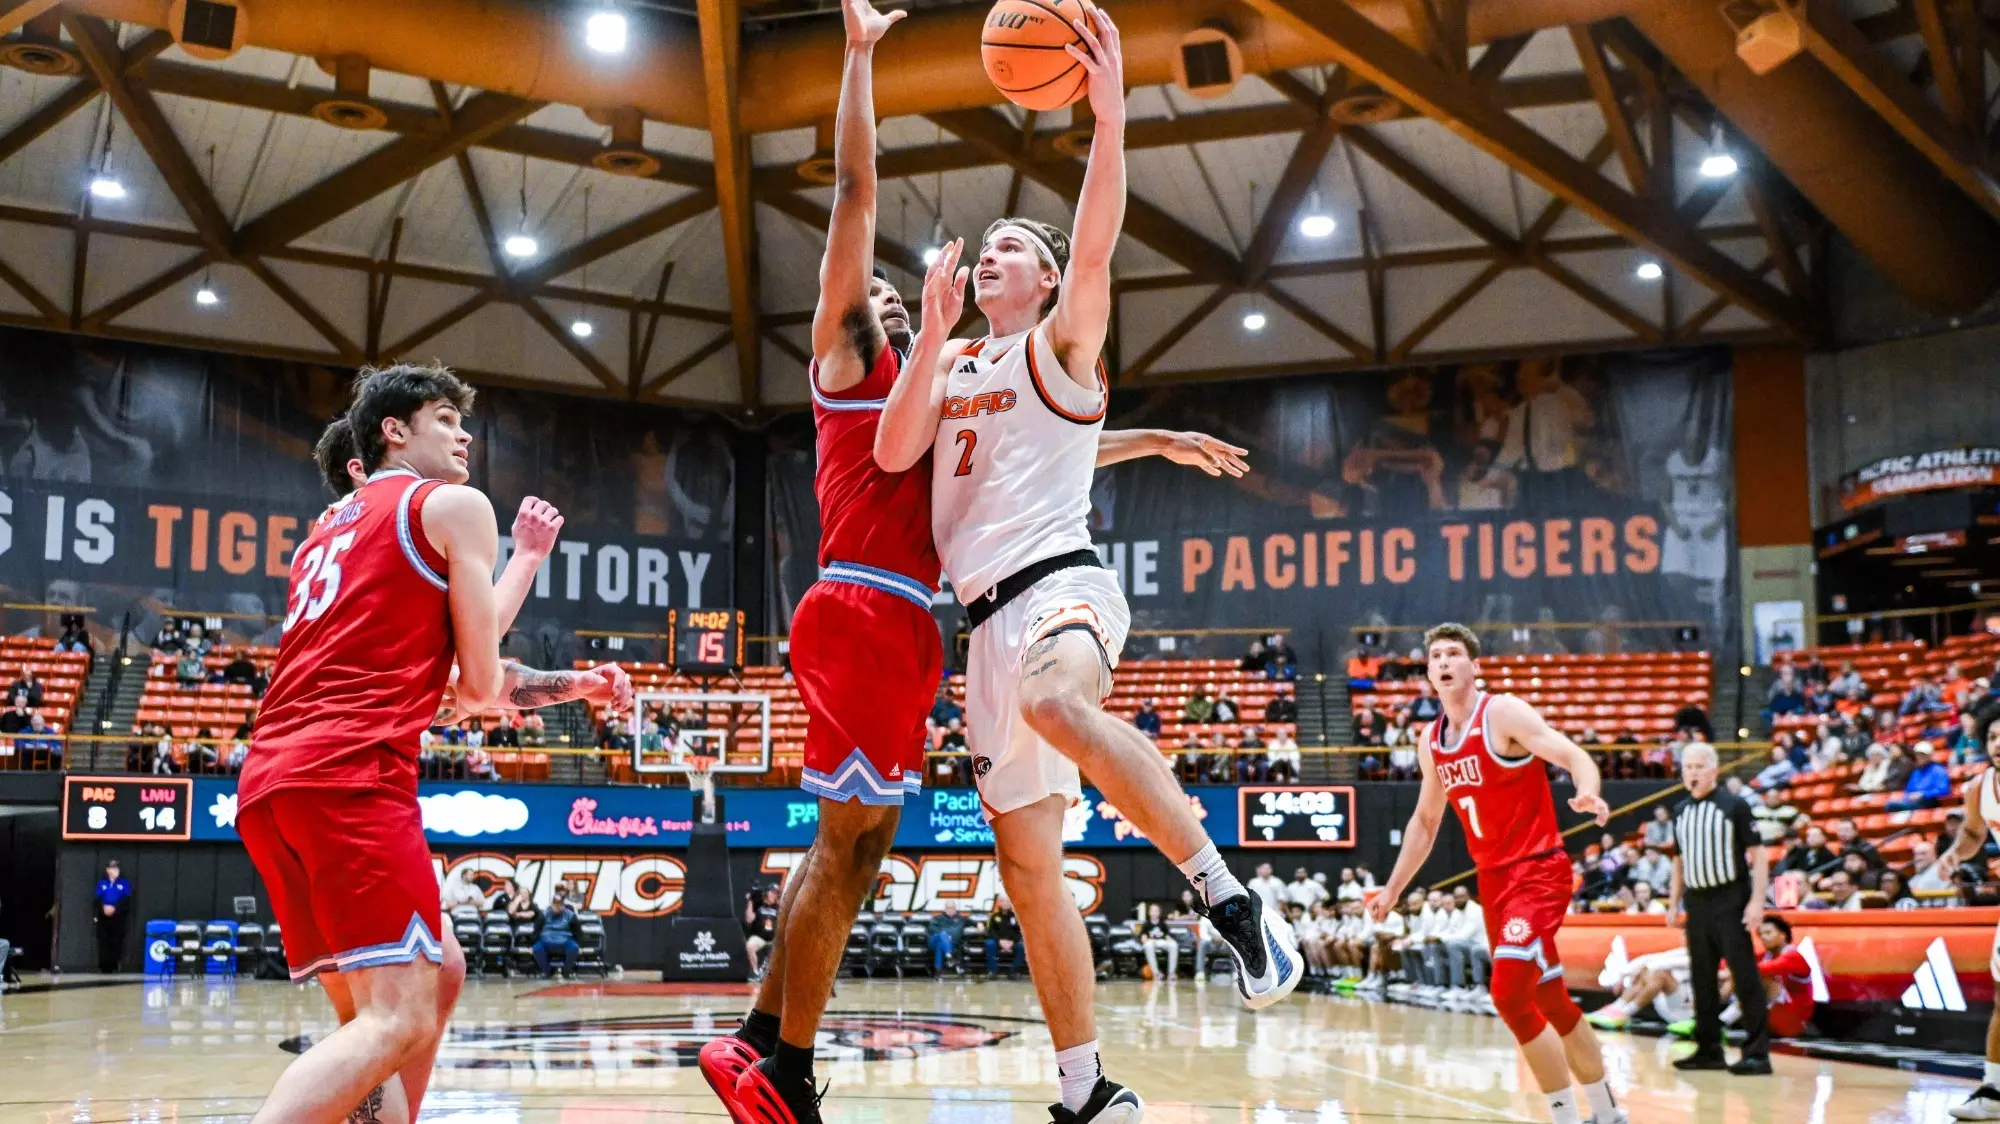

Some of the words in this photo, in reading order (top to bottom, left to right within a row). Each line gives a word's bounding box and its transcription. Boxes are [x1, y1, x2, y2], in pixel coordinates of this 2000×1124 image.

[953, 429, 978, 477] 2
[44, 495, 115, 565] IS
[147, 504, 314, 577] TIGE
[1096, 540, 1159, 596] HE
[1182, 528, 1417, 593] PACIFIC
[1441, 515, 1661, 581] TIGERS
[282, 529, 358, 633] 35
[688, 611, 730, 630] 14:02
[698, 631, 725, 663] 15
[1437, 755, 1484, 793] LMU
[82, 787, 116, 802] PAC
[140, 788, 176, 802] LMU
[934, 790, 982, 810] Pacif
[87, 806, 107, 829] 8
[139, 807, 176, 831] 14
[930, 811, 990, 829] HomeC
[1458, 795, 1484, 839] 7
[954, 827, 996, 843] Servic
